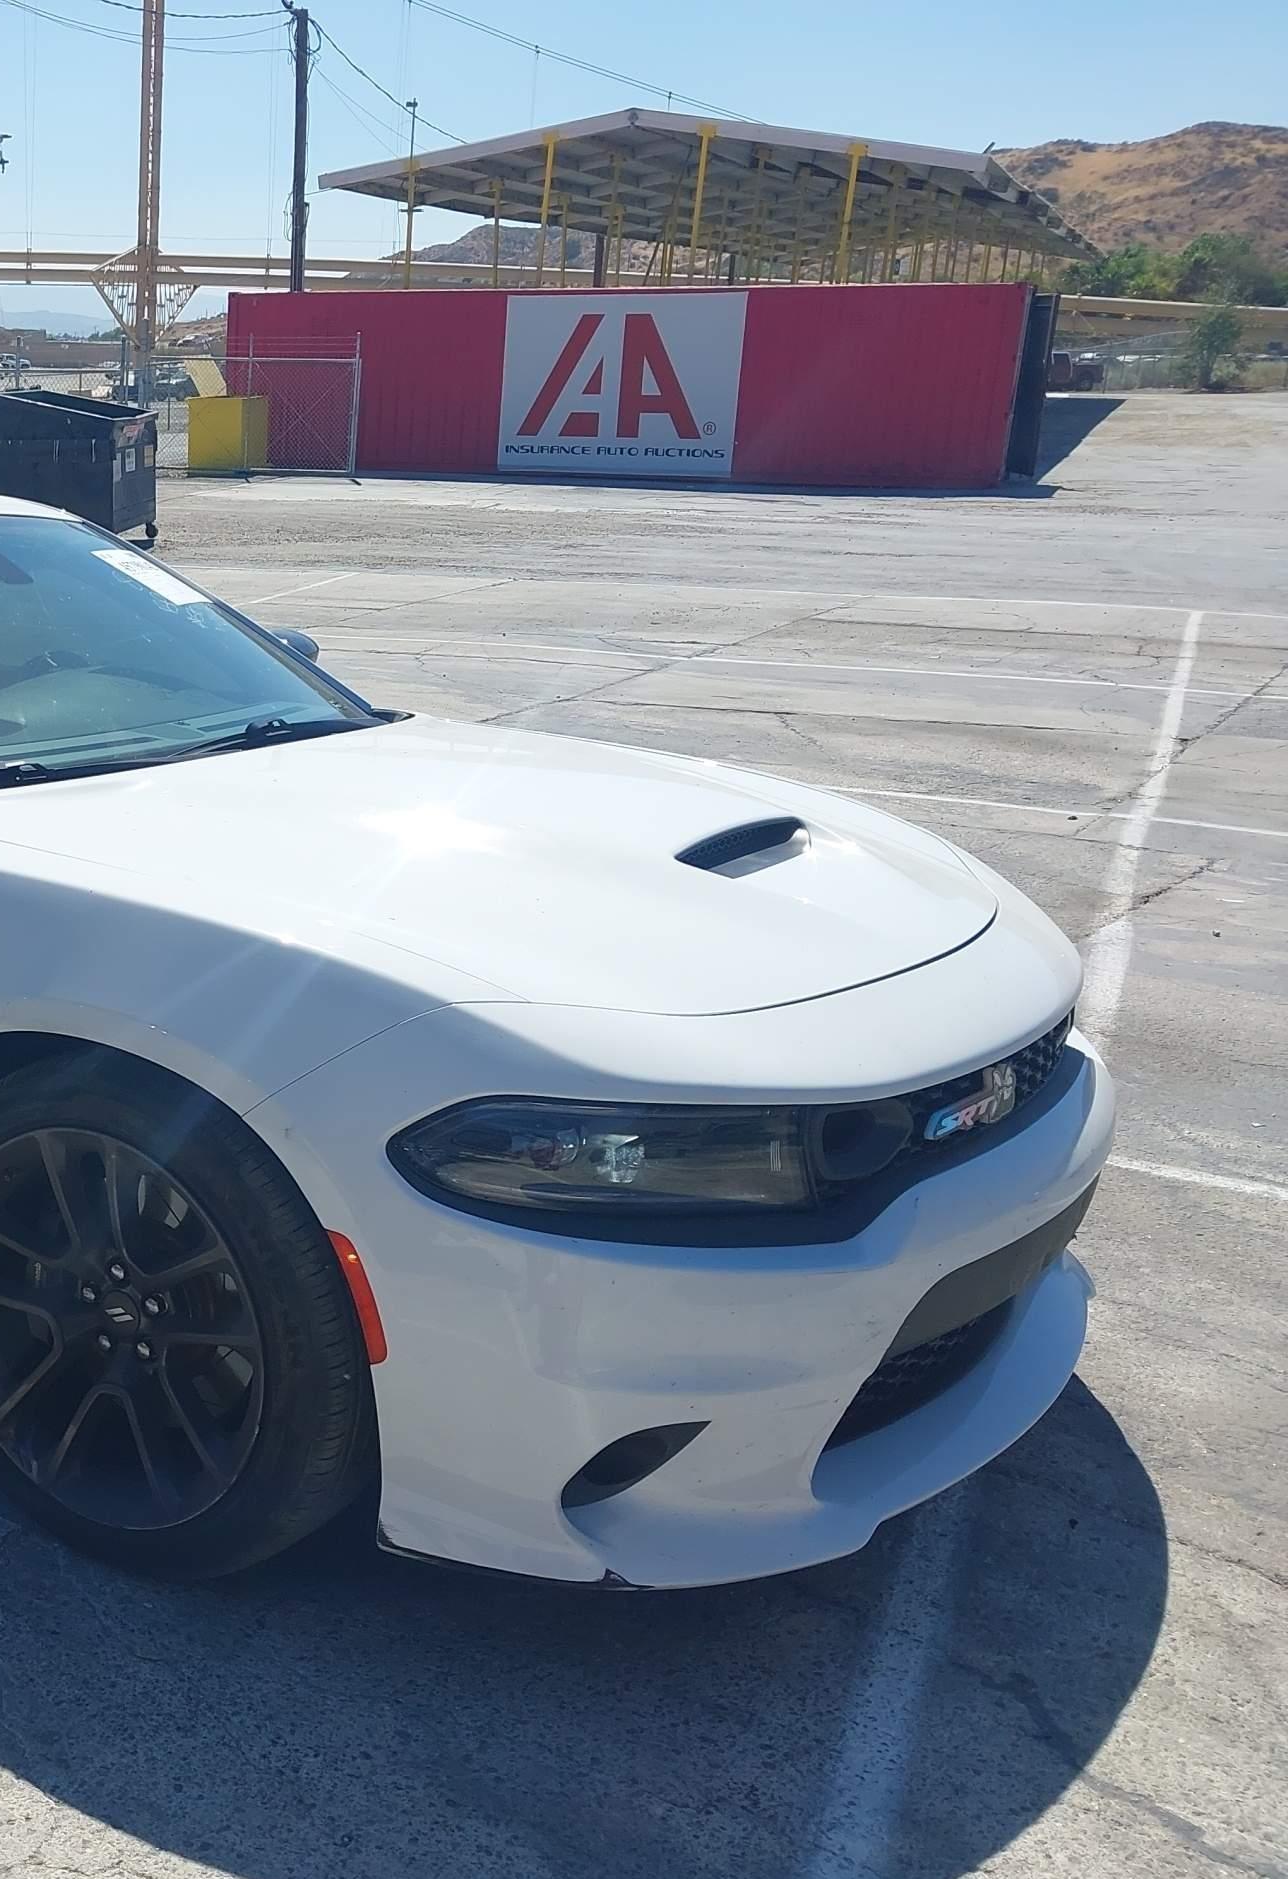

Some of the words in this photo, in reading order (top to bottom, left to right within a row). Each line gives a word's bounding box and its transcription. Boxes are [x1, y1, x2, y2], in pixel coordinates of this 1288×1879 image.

[505, 444, 592, 456] INSURANCE
[596, 446, 639, 457] AUTO
[644, 447, 725, 459] AUCTIONS
[933, 1095, 996, 1137] SRT
